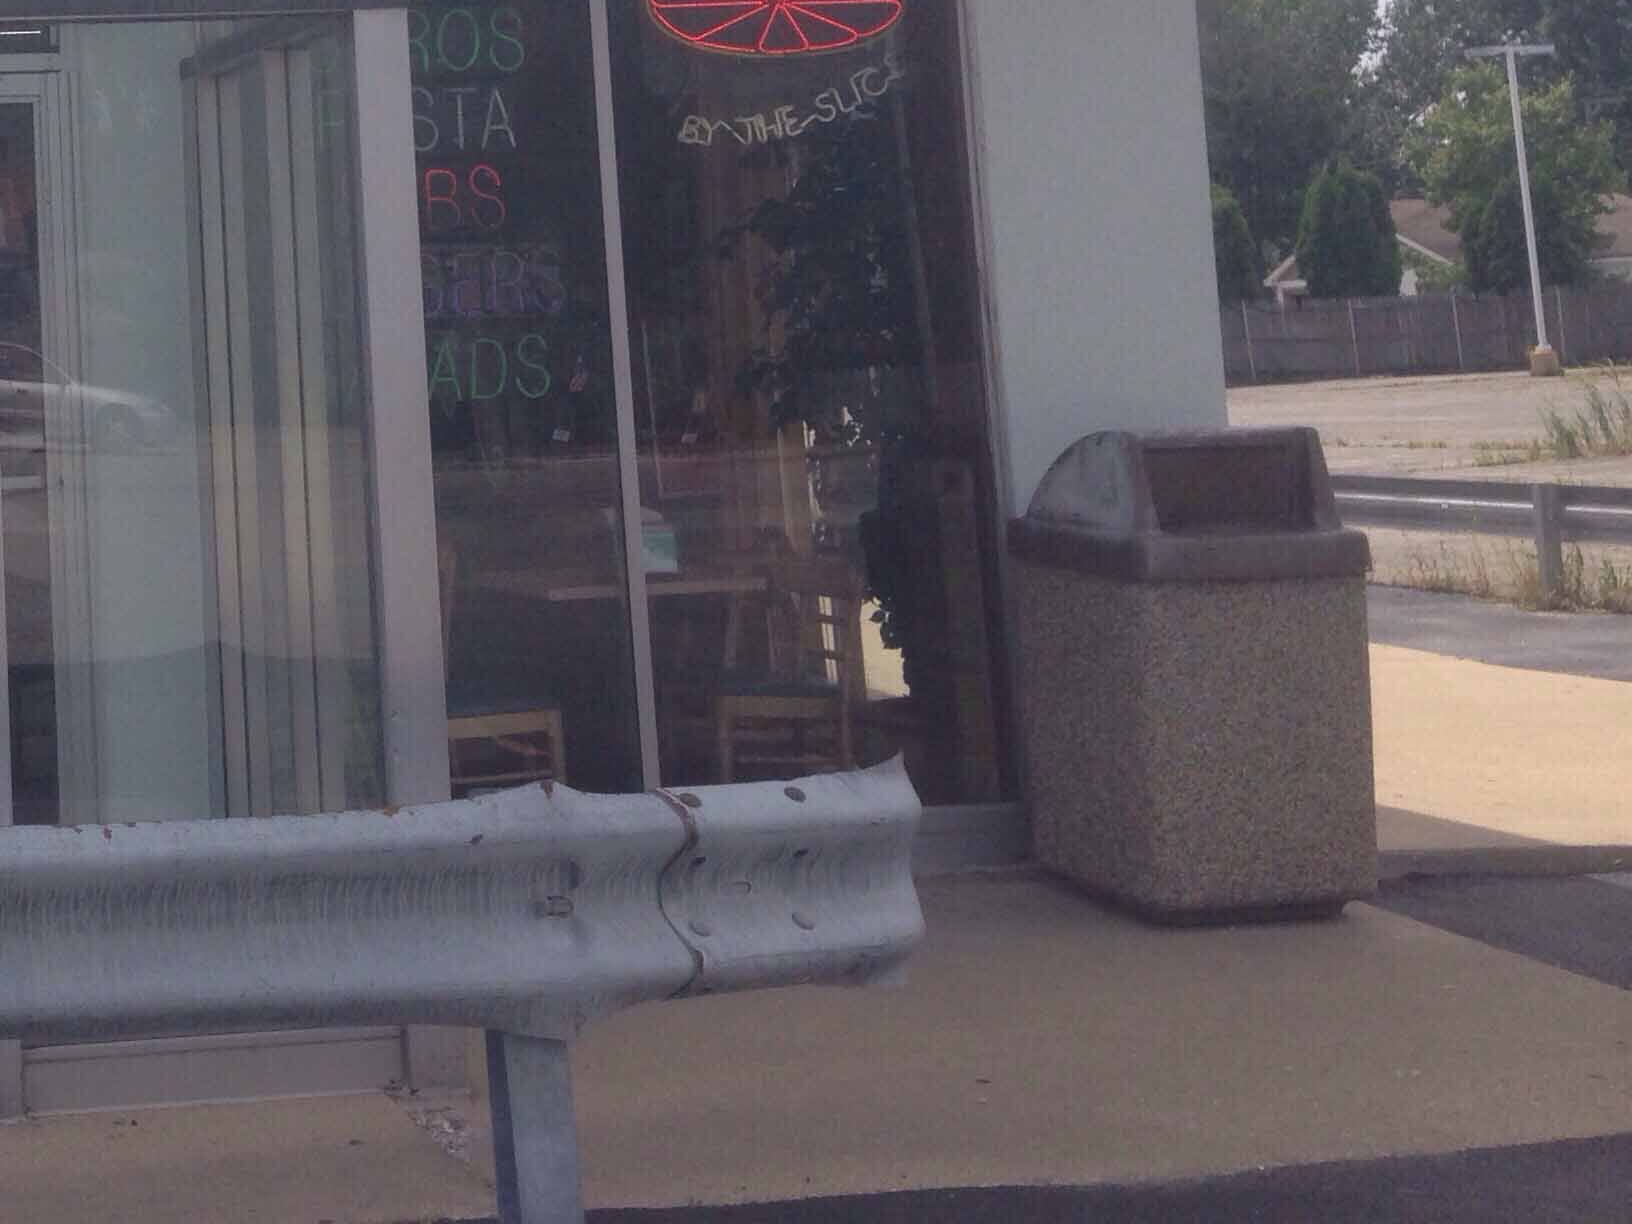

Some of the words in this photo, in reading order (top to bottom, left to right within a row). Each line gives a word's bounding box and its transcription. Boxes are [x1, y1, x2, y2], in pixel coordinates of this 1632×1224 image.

[409, 7, 526, 74] ROS
[412, 86, 517, 153] STA
[423, 163, 507, 232] BS
[428, 332, 553, 401] ADS
